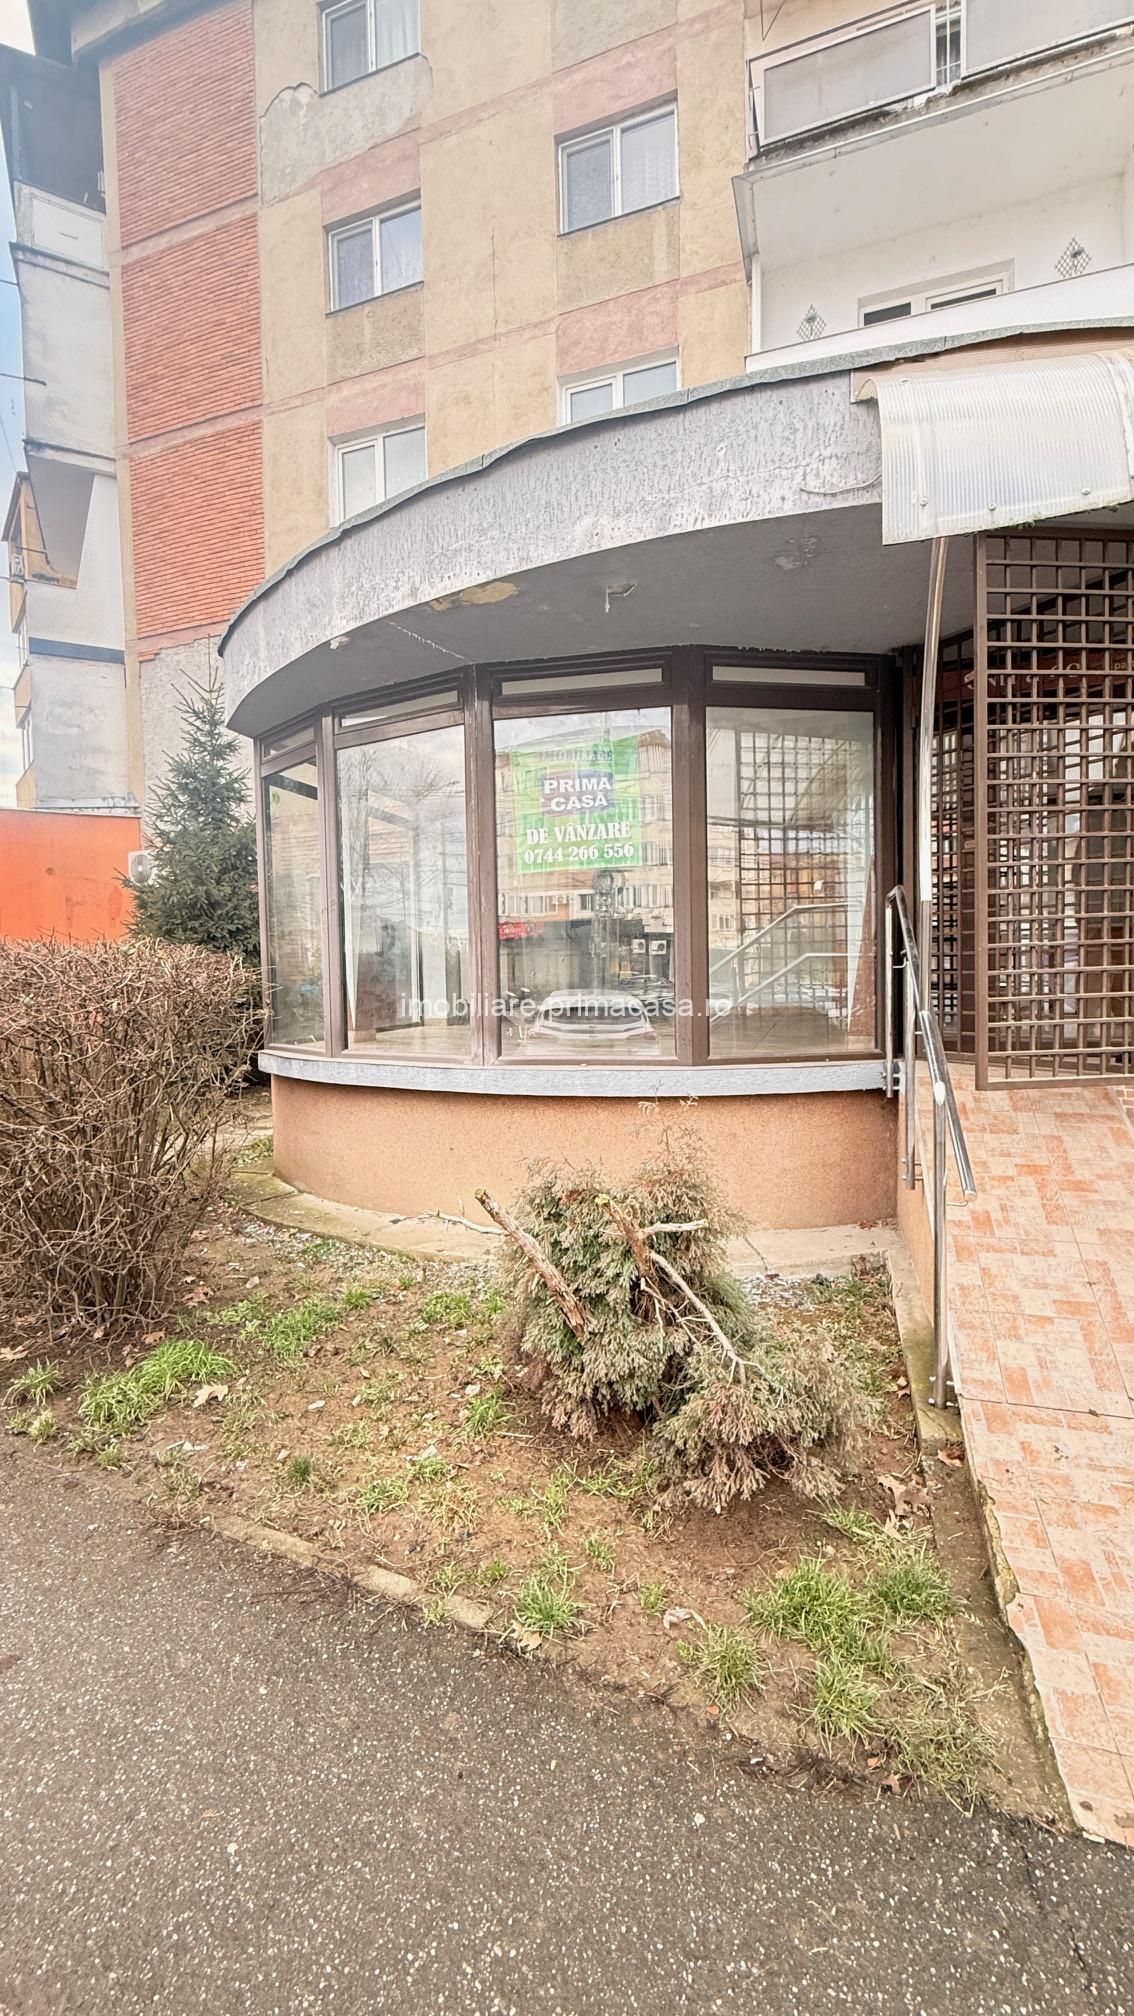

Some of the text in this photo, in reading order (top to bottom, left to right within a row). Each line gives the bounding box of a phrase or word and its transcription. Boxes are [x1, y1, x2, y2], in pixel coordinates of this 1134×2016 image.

[543, 777, 612, 794] PRIMA
[526, 821, 631, 845] DE VÂNZARE
[524, 842, 634, 864] 0744 266 556
